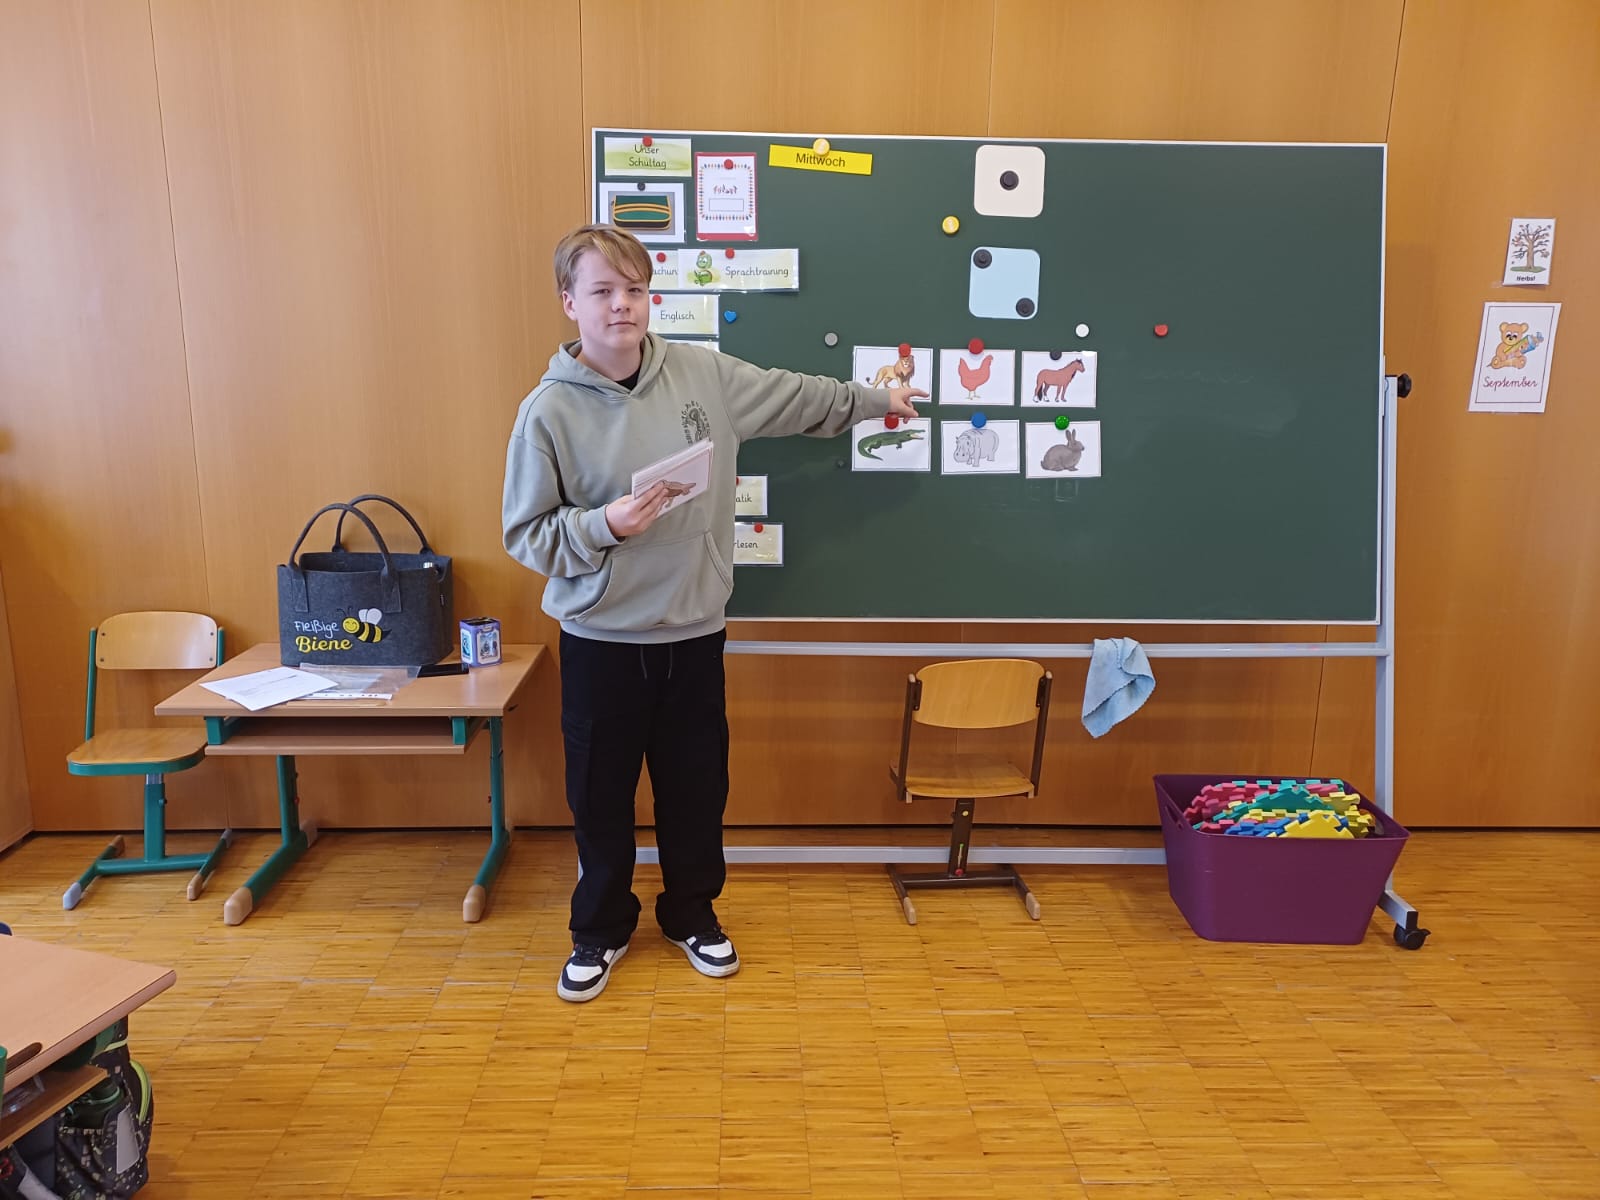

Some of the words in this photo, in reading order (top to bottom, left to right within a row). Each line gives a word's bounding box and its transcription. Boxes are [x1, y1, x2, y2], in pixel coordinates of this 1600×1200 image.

[634, 143, 659, 153] Unser
[628, 156, 667, 170] Schultag
[796, 153, 846, 167] Mittwoch
[725, 266, 789, 278] Sprachtraining
[660, 310, 695, 323] Englisch
[1482, 376, 1538, 391] September
[295, 620, 340, 638] Fleißige
[295, 635, 353, 653] Biene
